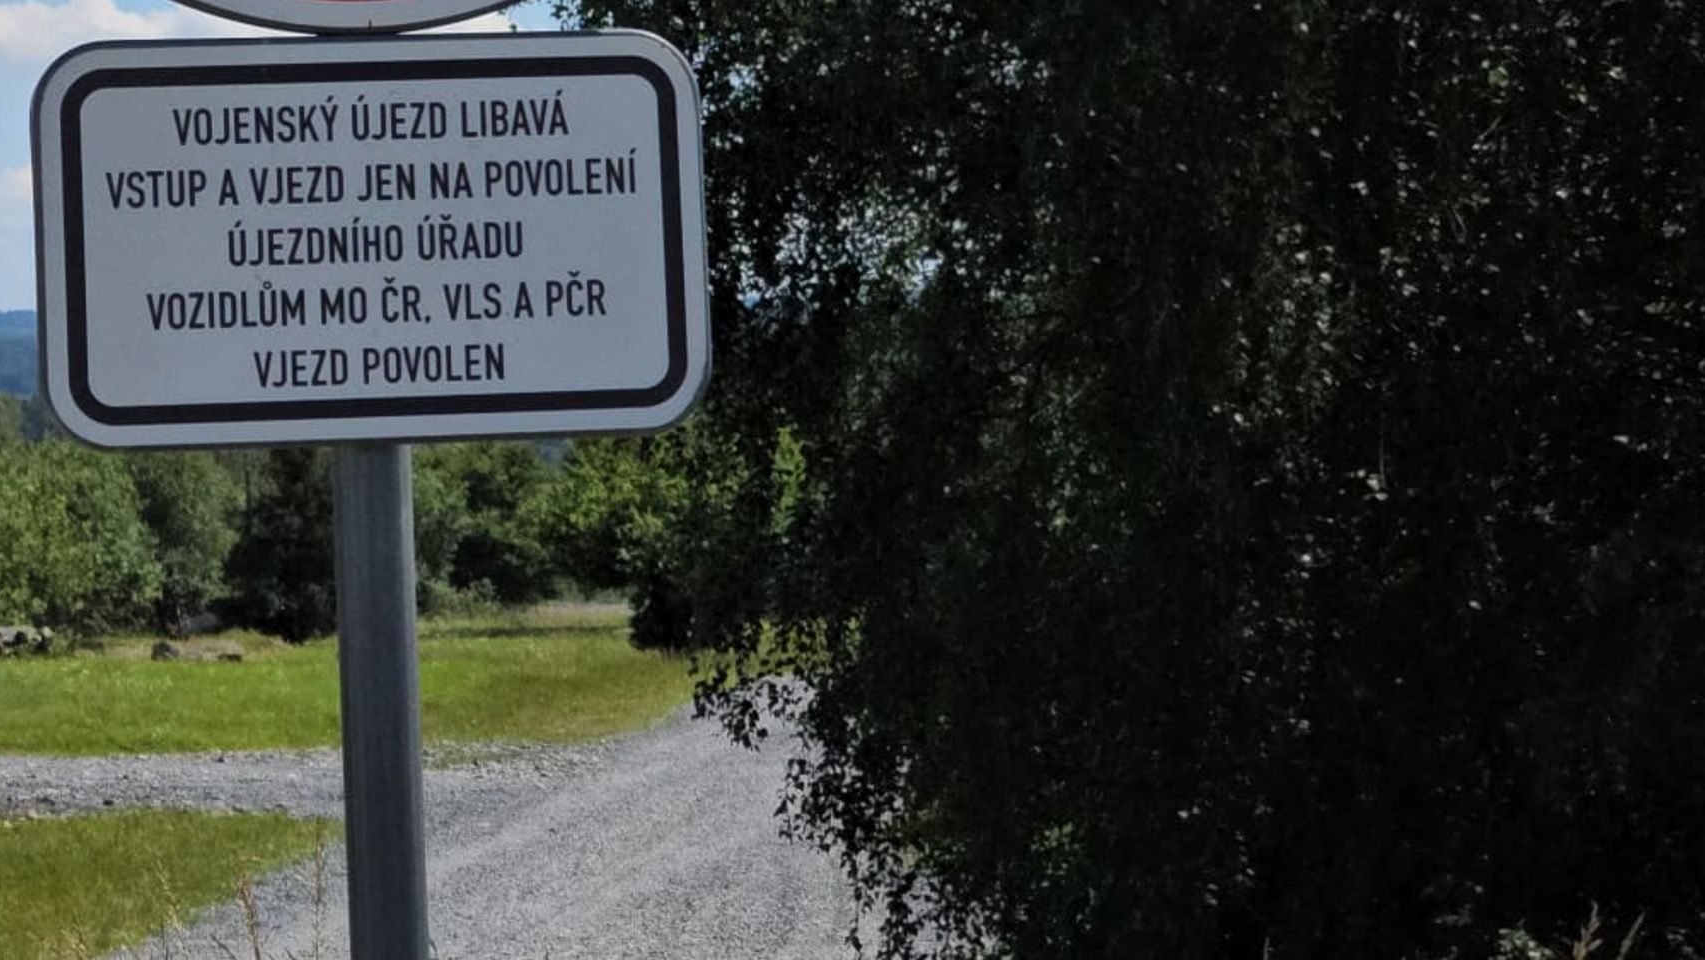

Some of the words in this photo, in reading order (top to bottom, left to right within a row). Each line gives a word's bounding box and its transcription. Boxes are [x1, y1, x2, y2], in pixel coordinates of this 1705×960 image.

[172, 95, 339, 146] VOJENSKÝ
[350, 93, 448, 142] ÚJEZD
[460, 89, 569, 139] LIBAVÁ
[105, 168, 208, 210] VSTUP
[218, 167, 240, 206] A
[249, 164, 345, 205] VJEZD
[357, 162, 416, 202] JEN
[430, 160, 474, 200] NA
[485, 148, 637, 199] POVOLENÍ
[227, 216, 404, 267] ÚJEZDNÍHO
[417, 213, 524, 261] ÚŘADU
[146, 280, 307, 331] VOZIDLŮM
[320, 285, 368, 325] MO
[381, 275, 432, 324] ČR,
[443, 281, 503, 321] VLS
[514, 280, 535, 319] A
[546, 269, 608, 318] PČR
[253, 348, 349, 388] VJEZD
[362, 342, 506, 386] POVOLEN
